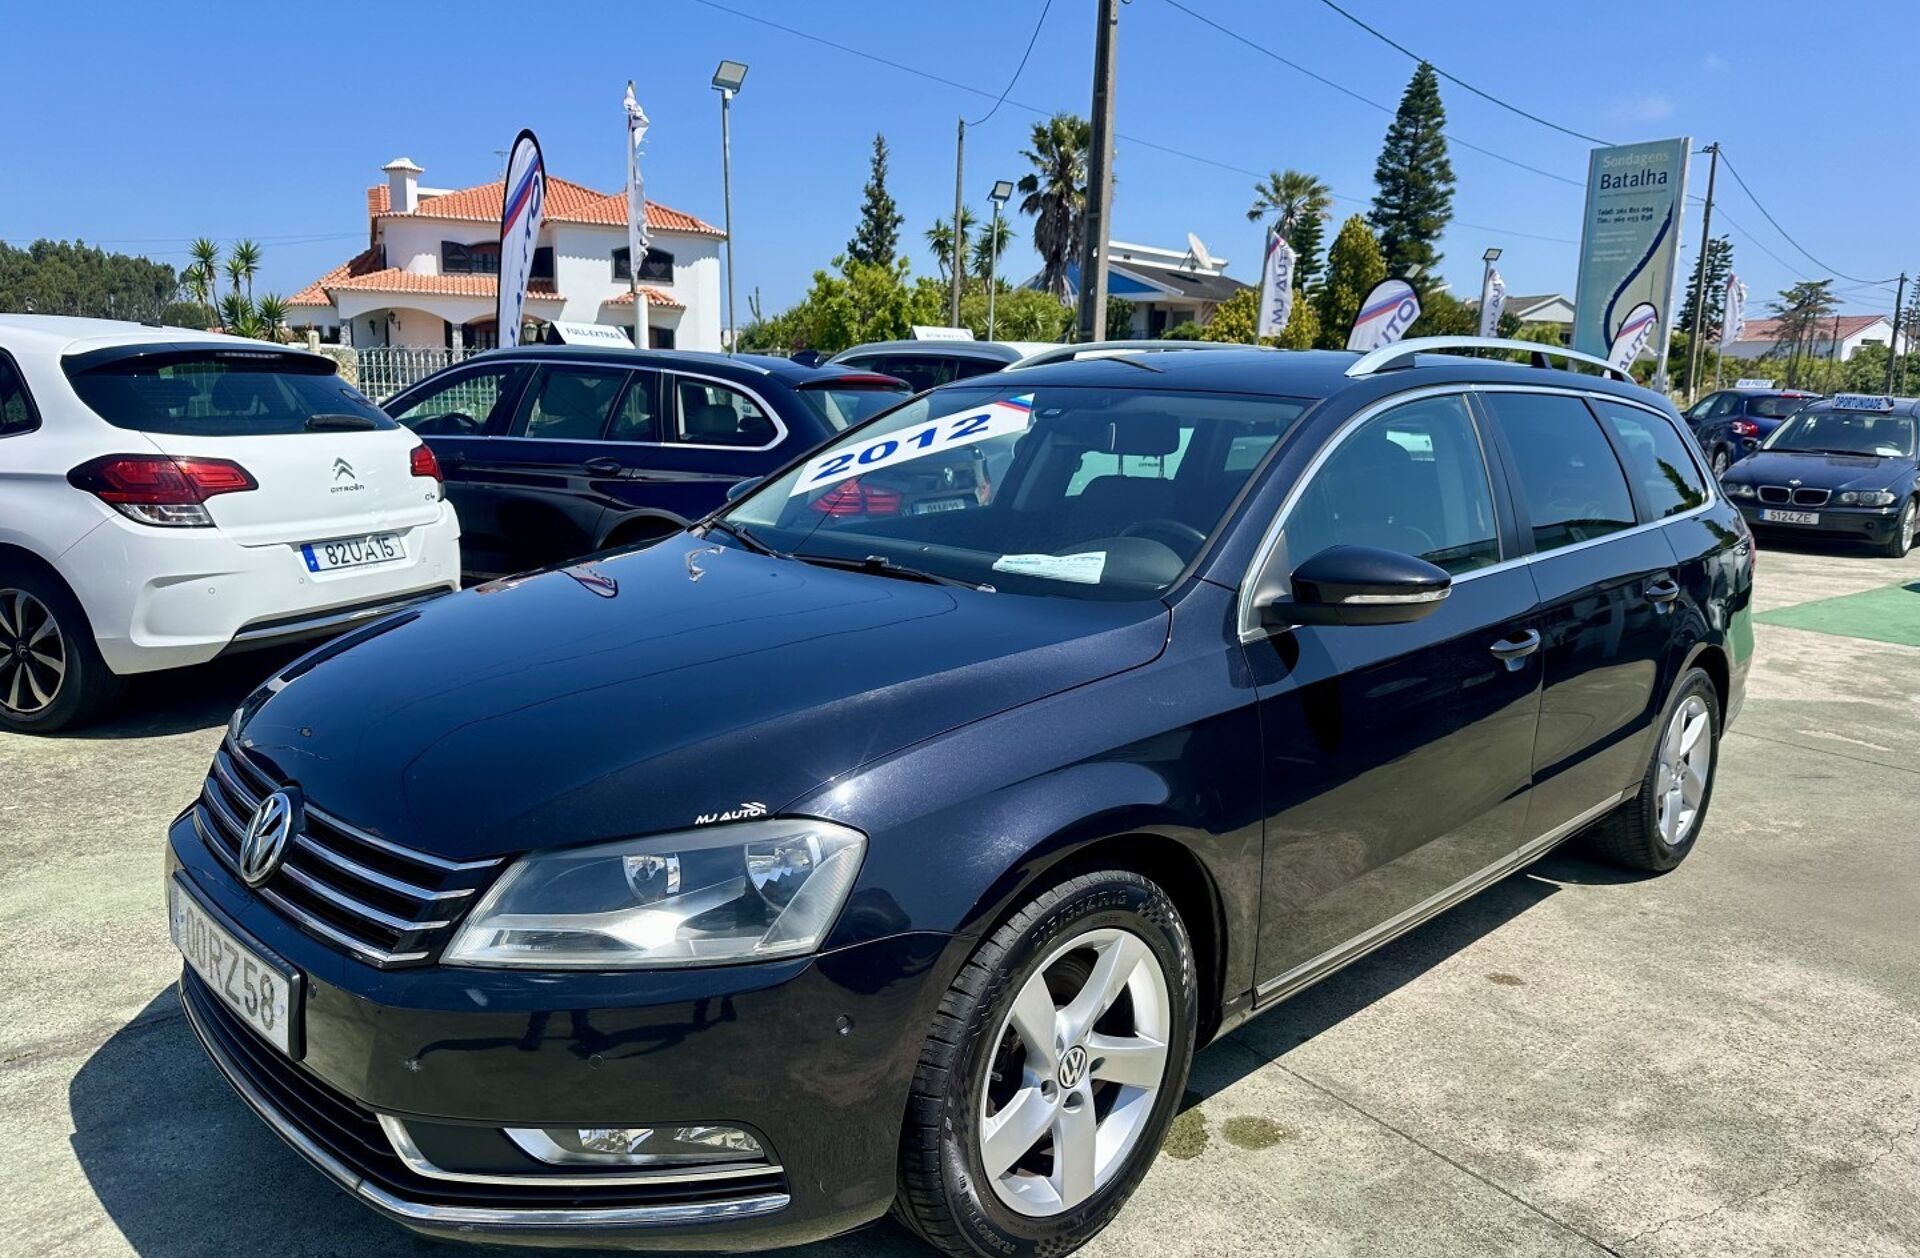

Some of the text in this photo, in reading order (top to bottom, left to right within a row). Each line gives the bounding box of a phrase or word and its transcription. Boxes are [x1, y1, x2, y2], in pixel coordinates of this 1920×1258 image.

[1603, 151, 1669, 168] Sondagens
[1600, 168, 1668, 190] Batalha
[811, 413, 992, 483] 2012
[324, 537, 395, 566] 82UA15
[694, 807, 761, 825] MJ AUTO
